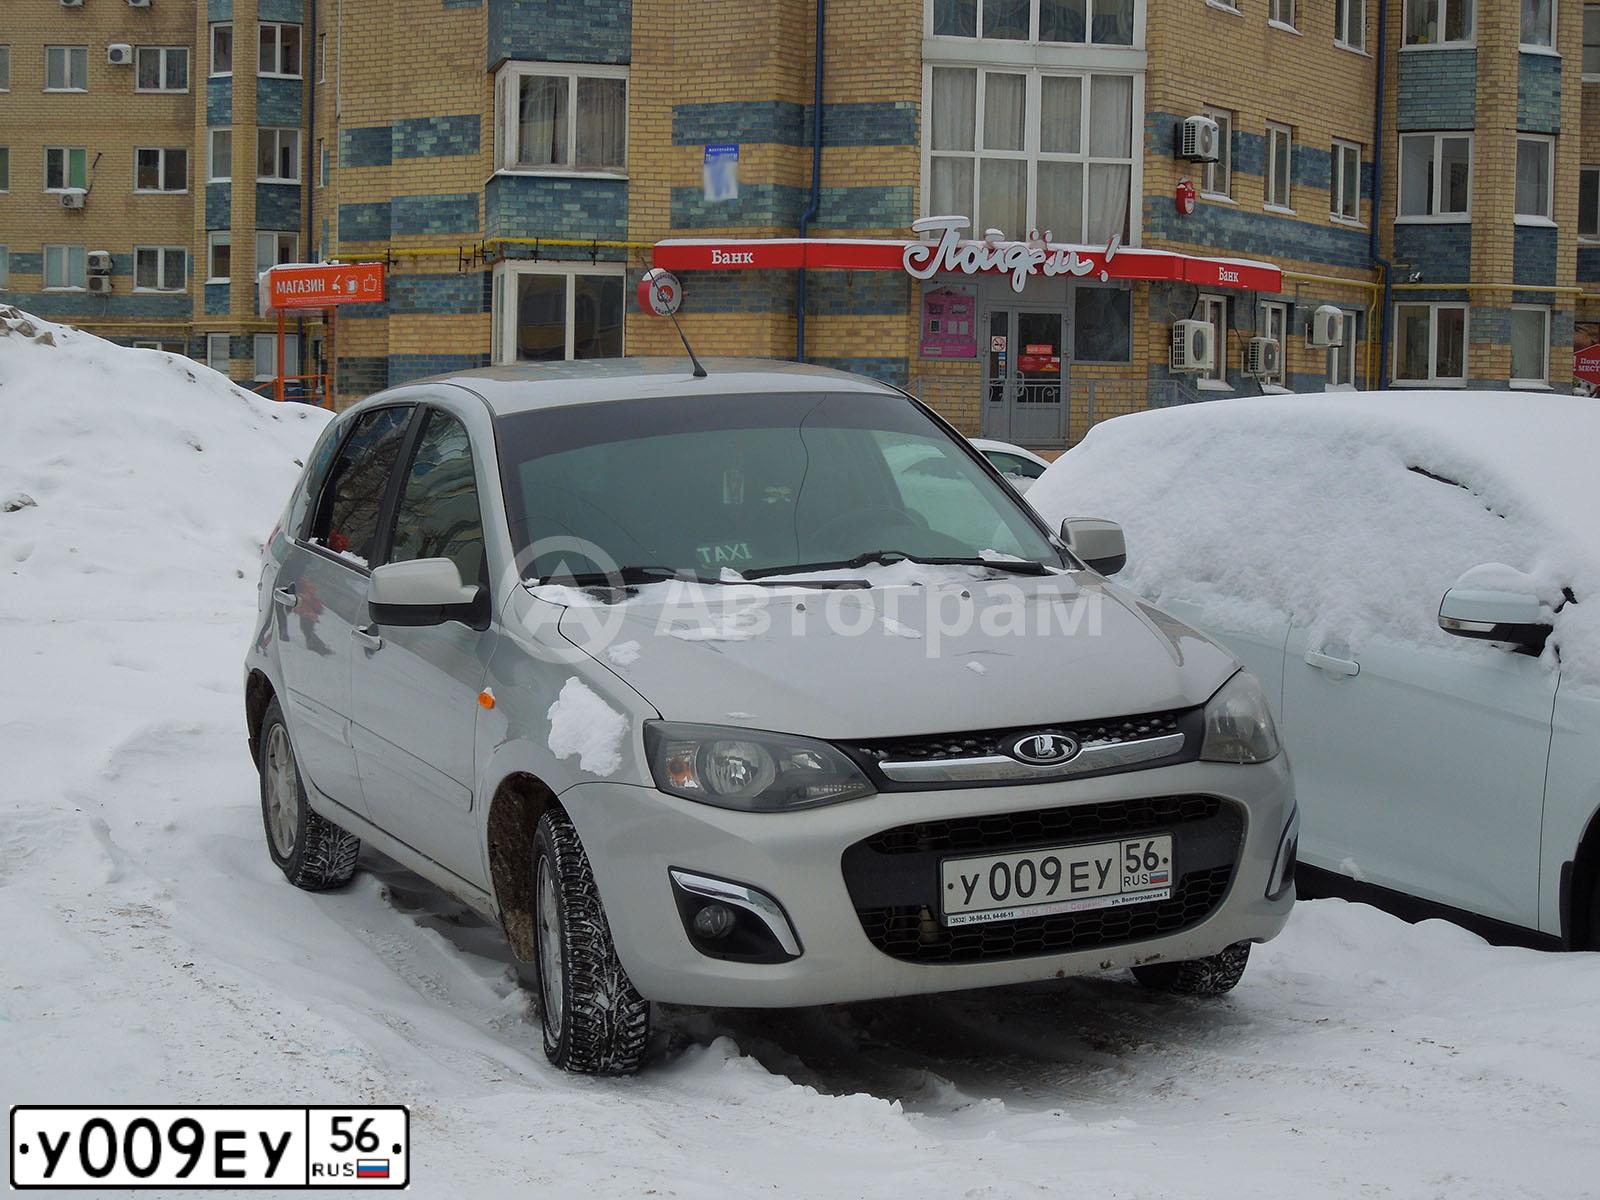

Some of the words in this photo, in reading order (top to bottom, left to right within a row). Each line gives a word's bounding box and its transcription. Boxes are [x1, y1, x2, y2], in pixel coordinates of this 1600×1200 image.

[711, 249, 754, 265] Банк
[1218, 266, 1239, 283] Банк
[276, 279, 326, 295] МАГАЗИН
[696, 543, 752, 563] TAXI
[1125, 841, 1160, 873] 56
[1123, 875, 1149, 888] RUS
